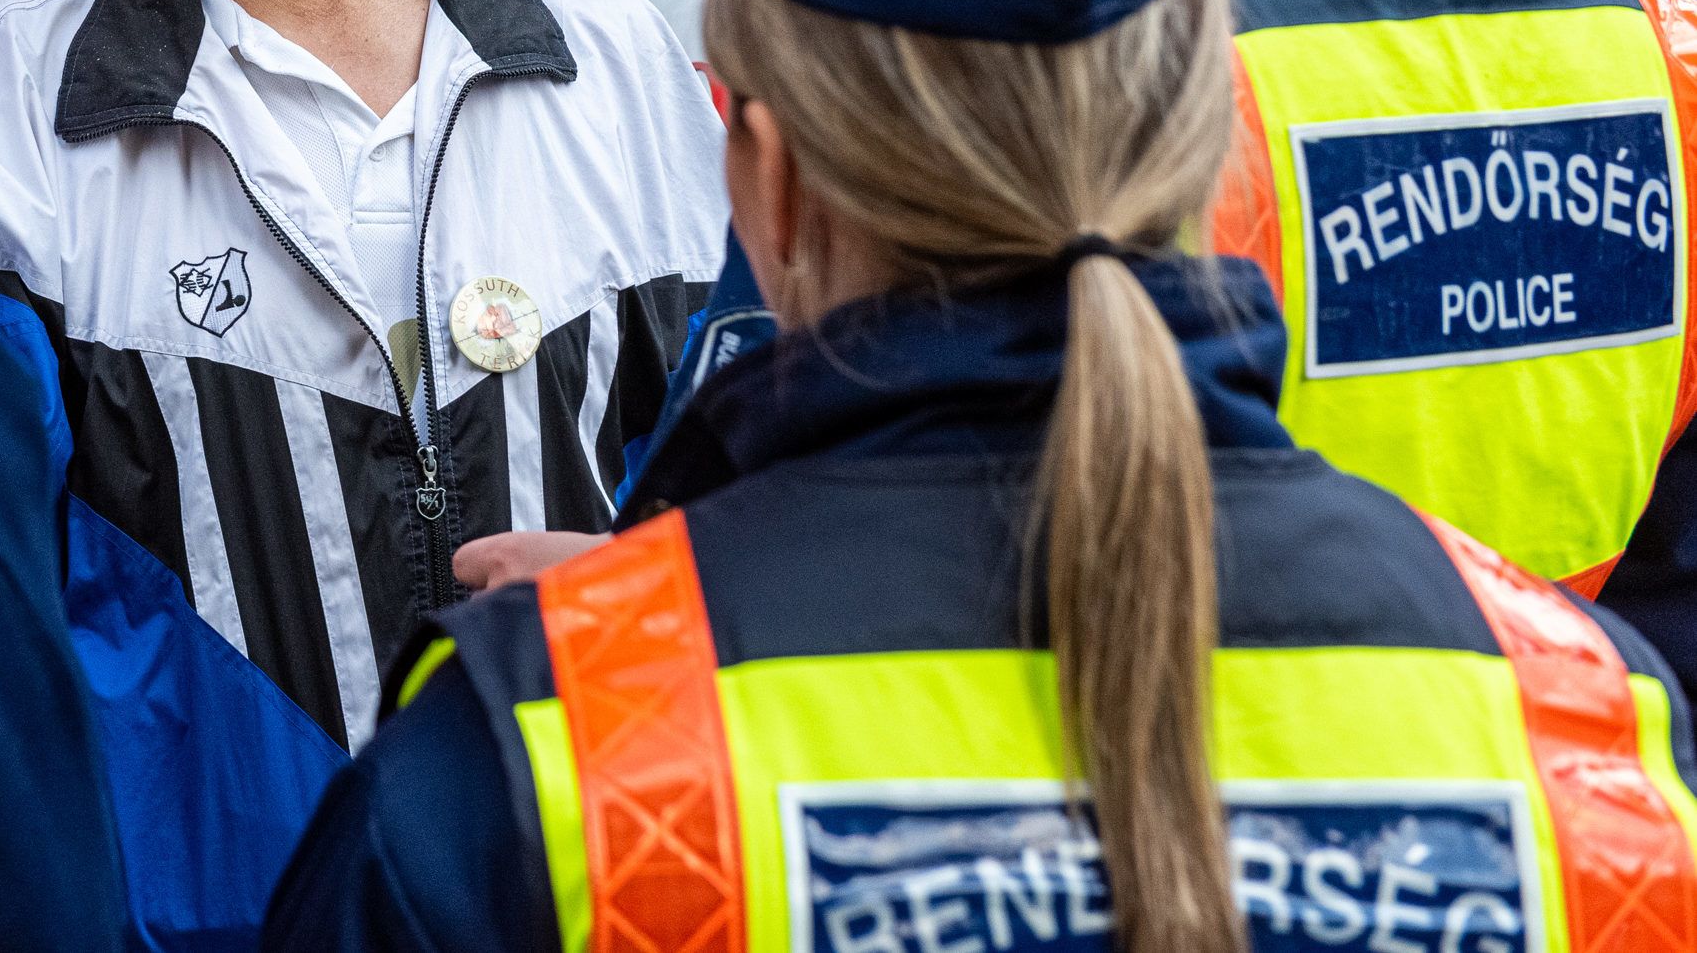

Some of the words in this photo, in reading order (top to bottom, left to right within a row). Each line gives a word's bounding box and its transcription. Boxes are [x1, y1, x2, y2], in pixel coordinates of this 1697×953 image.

[1319, 131, 1670, 285] RENDŐRSÉG
[454, 278, 520, 326] KOSSUTH
[1441, 272, 1577, 336] POLICE
